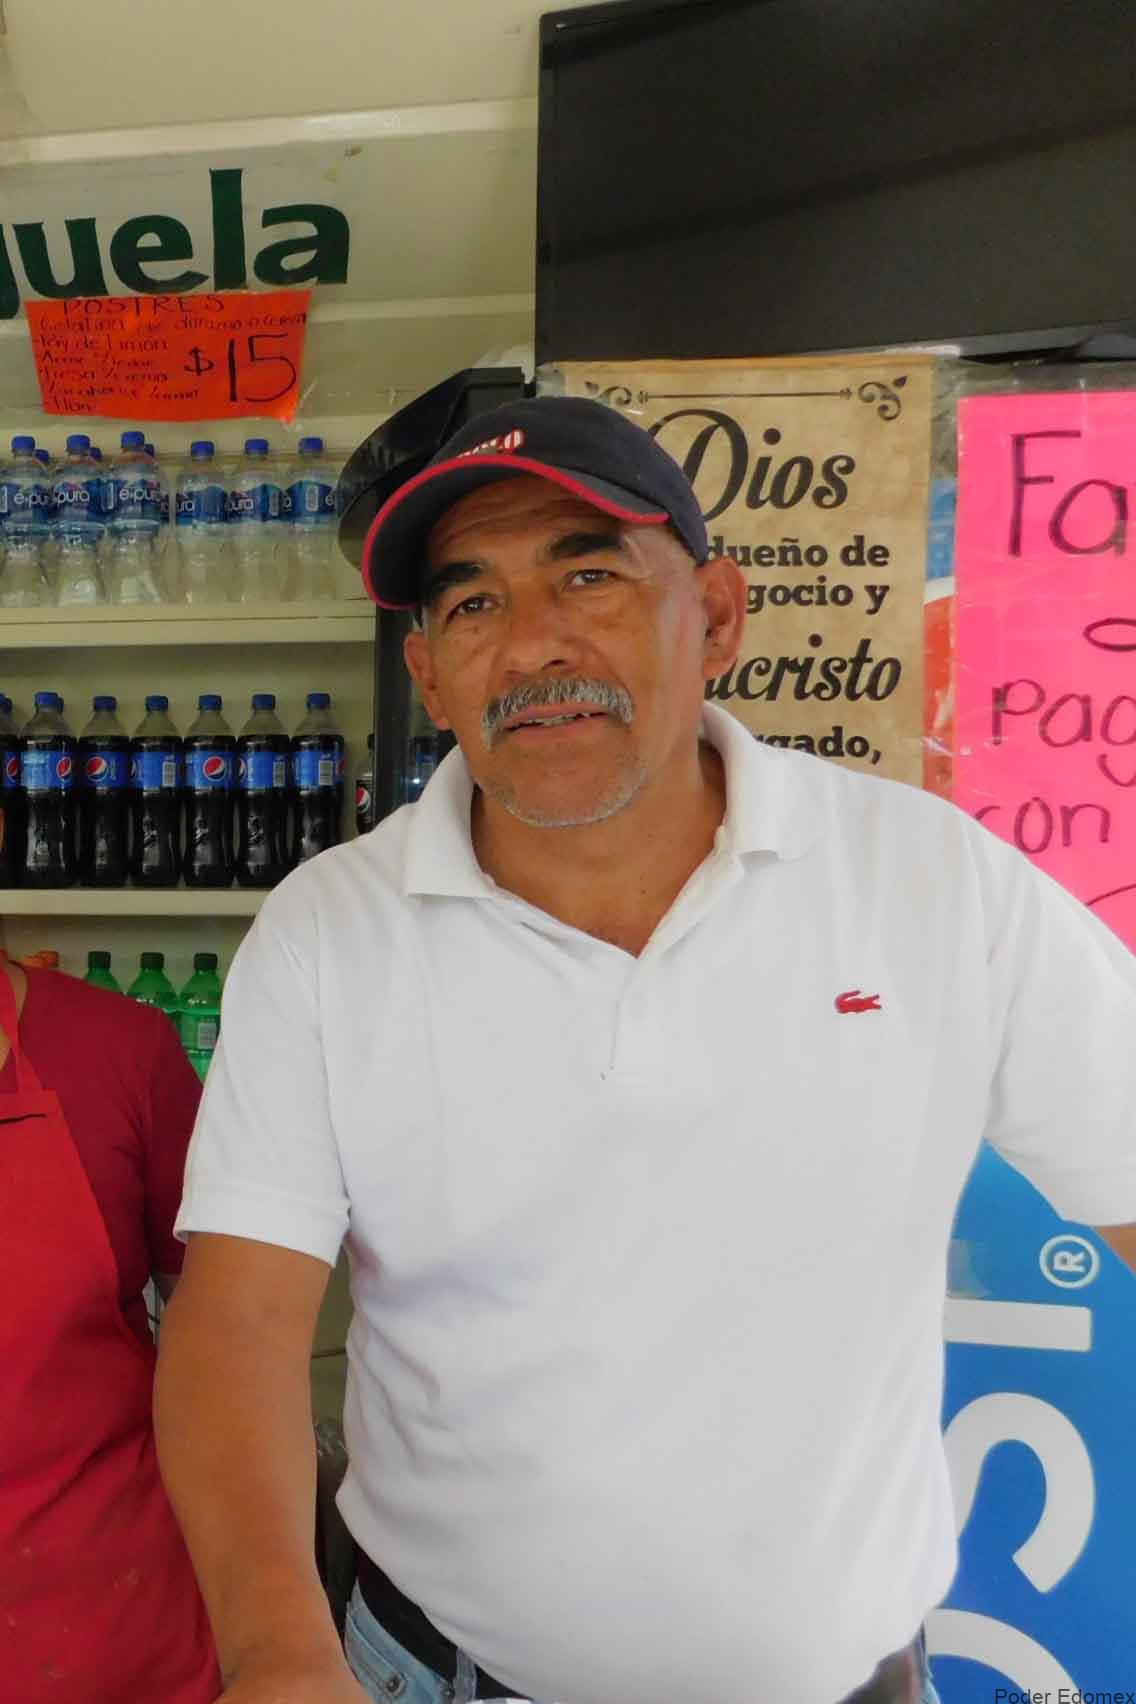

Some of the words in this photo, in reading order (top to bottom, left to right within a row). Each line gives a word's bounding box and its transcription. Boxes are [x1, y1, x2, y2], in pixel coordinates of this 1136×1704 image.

[183, 331, 297, 403] $15
[648, 408, 856, 522] Dios
[840, 534, 890, 568] de
[865, 583, 891, 615] y
